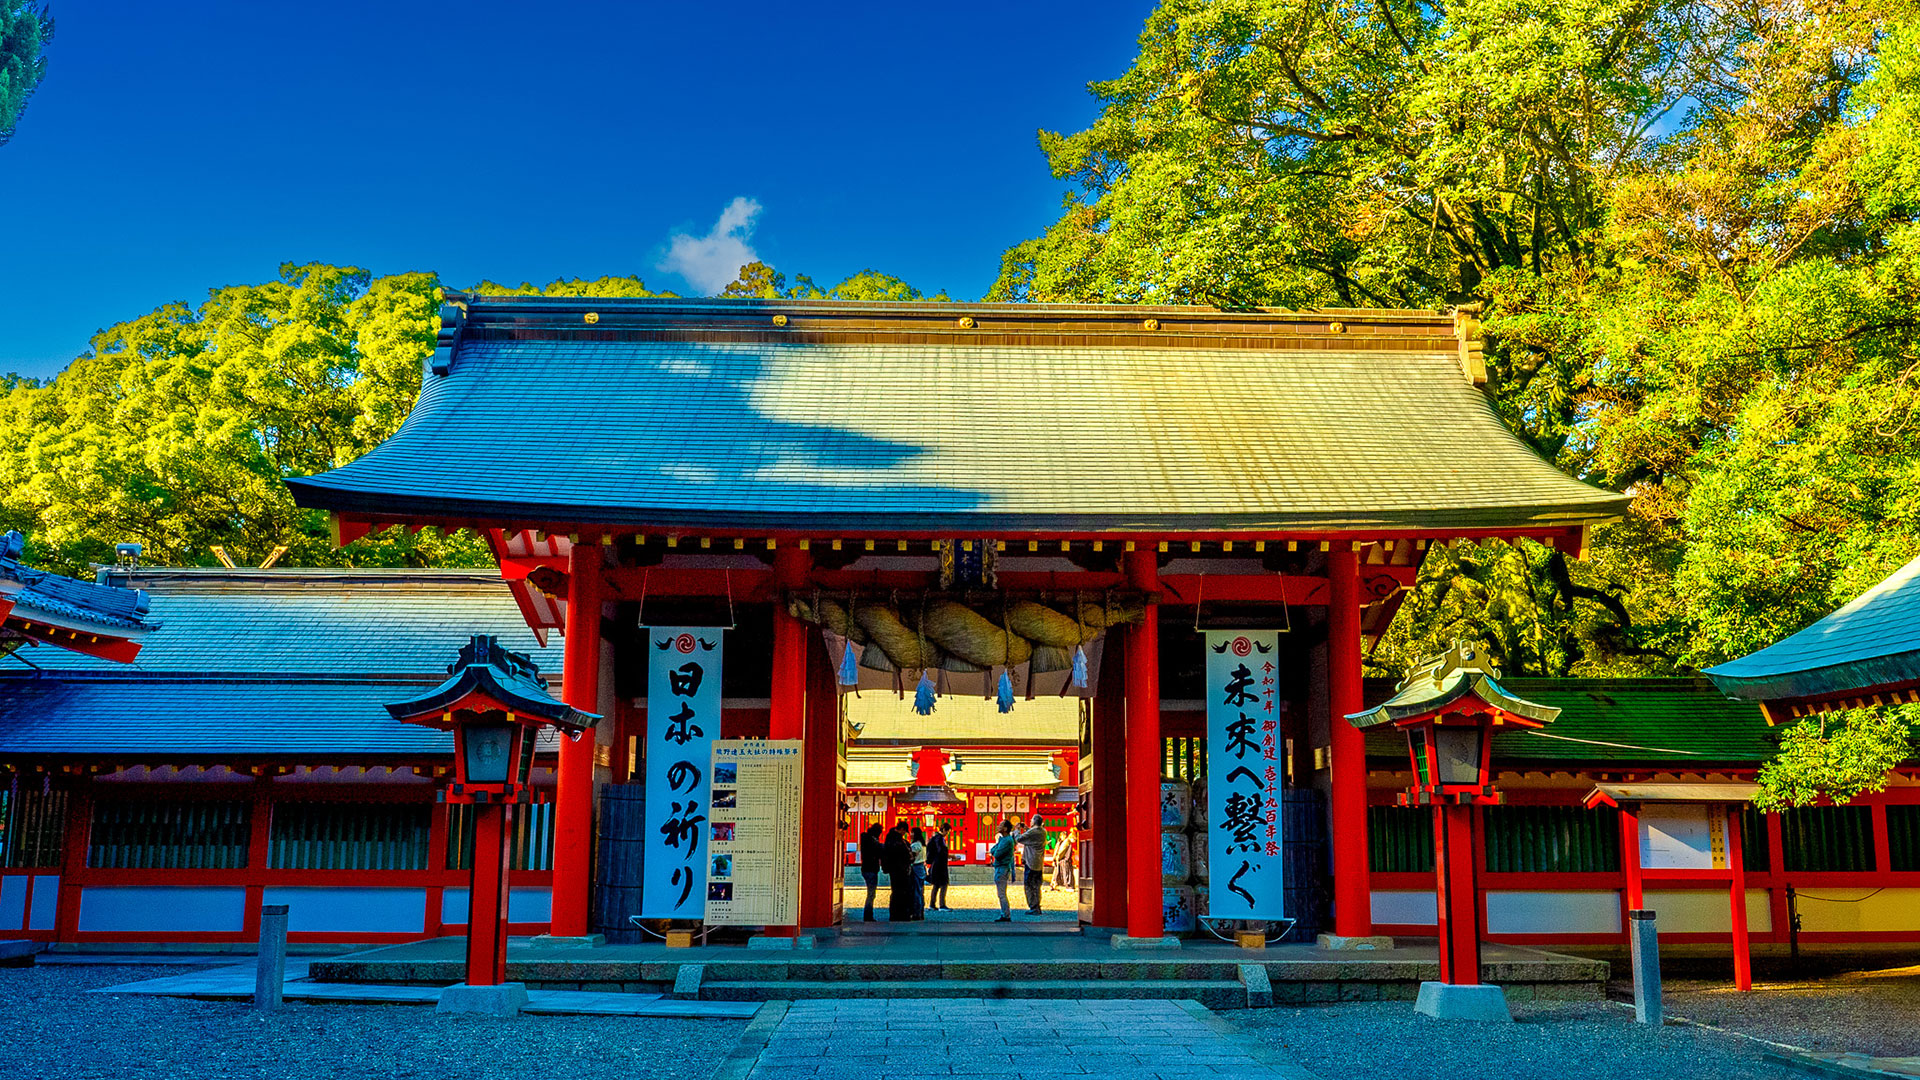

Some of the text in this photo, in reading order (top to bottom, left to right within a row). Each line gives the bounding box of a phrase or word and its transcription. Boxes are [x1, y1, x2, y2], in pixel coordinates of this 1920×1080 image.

[661, 662, 706, 911] 日本の祈り
[1261, 661, 1280, 856] 令和十年 御創建 壱千九百年祭
